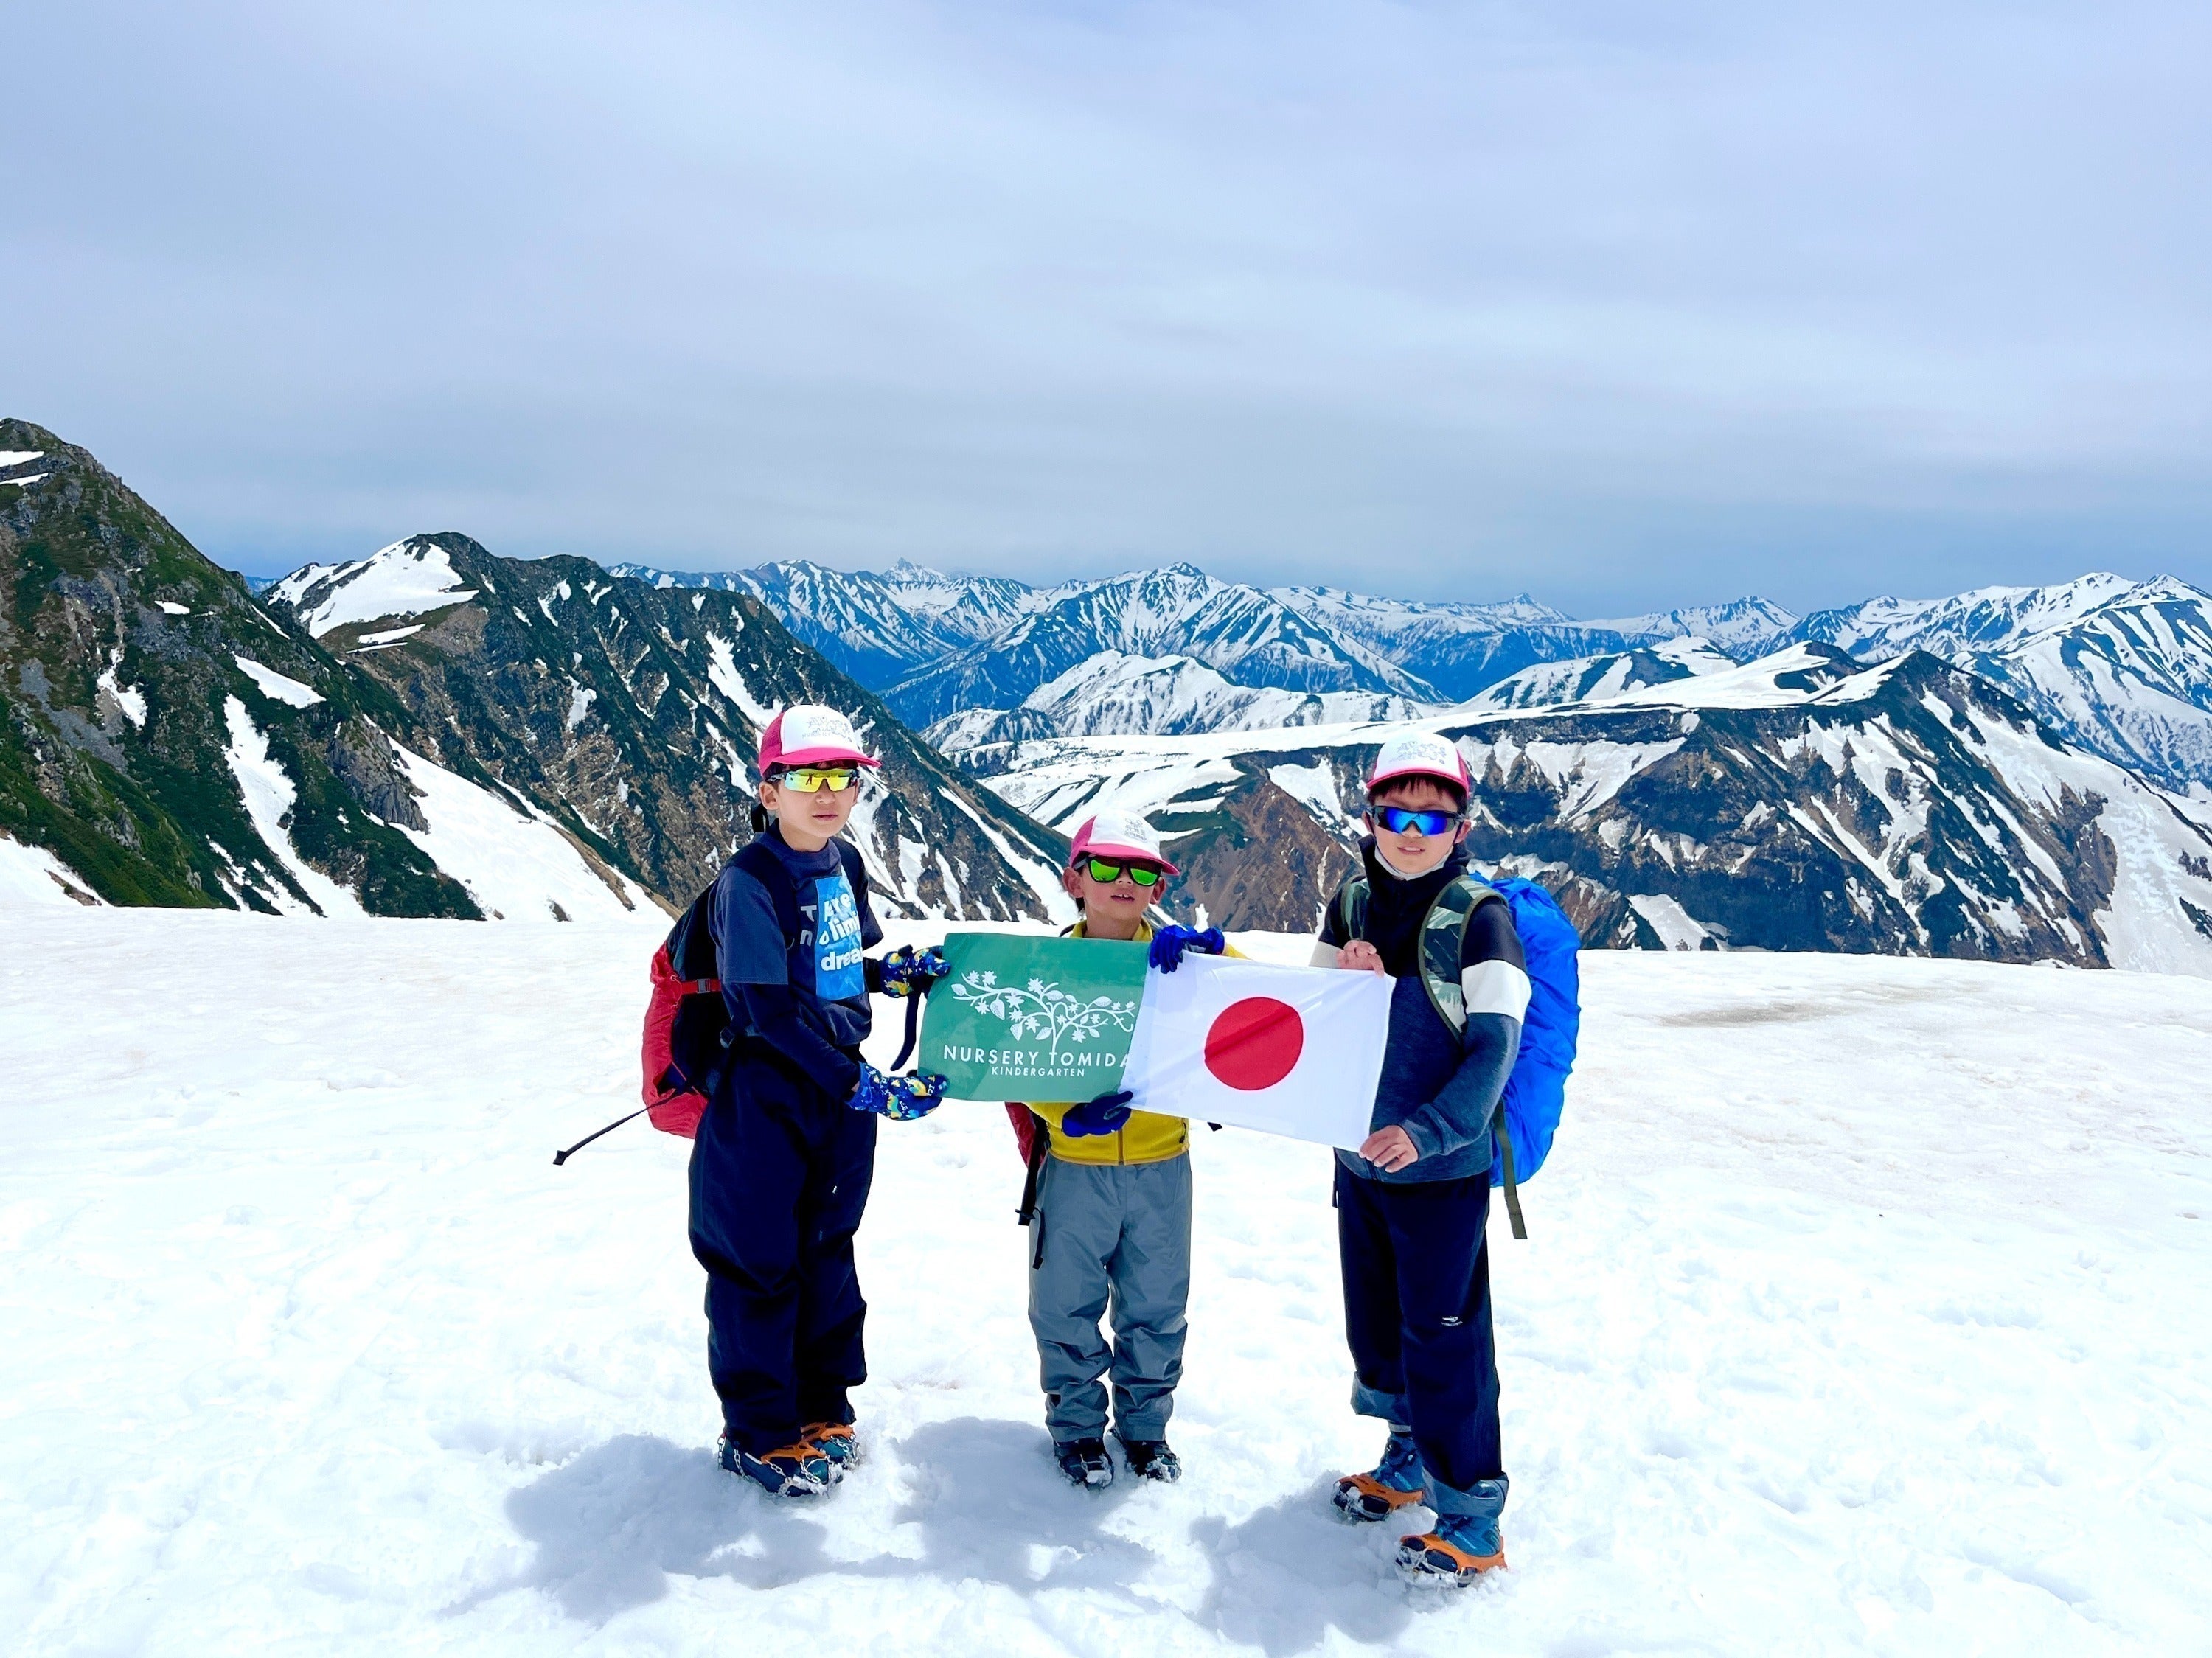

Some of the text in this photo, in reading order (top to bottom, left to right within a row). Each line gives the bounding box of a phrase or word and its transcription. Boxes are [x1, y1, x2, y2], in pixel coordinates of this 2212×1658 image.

[821, 947, 863, 971] drea
[944, 1045, 1039, 1065] NURSERY
[992, 1066, 1085, 1077] KINDERGARTEN
